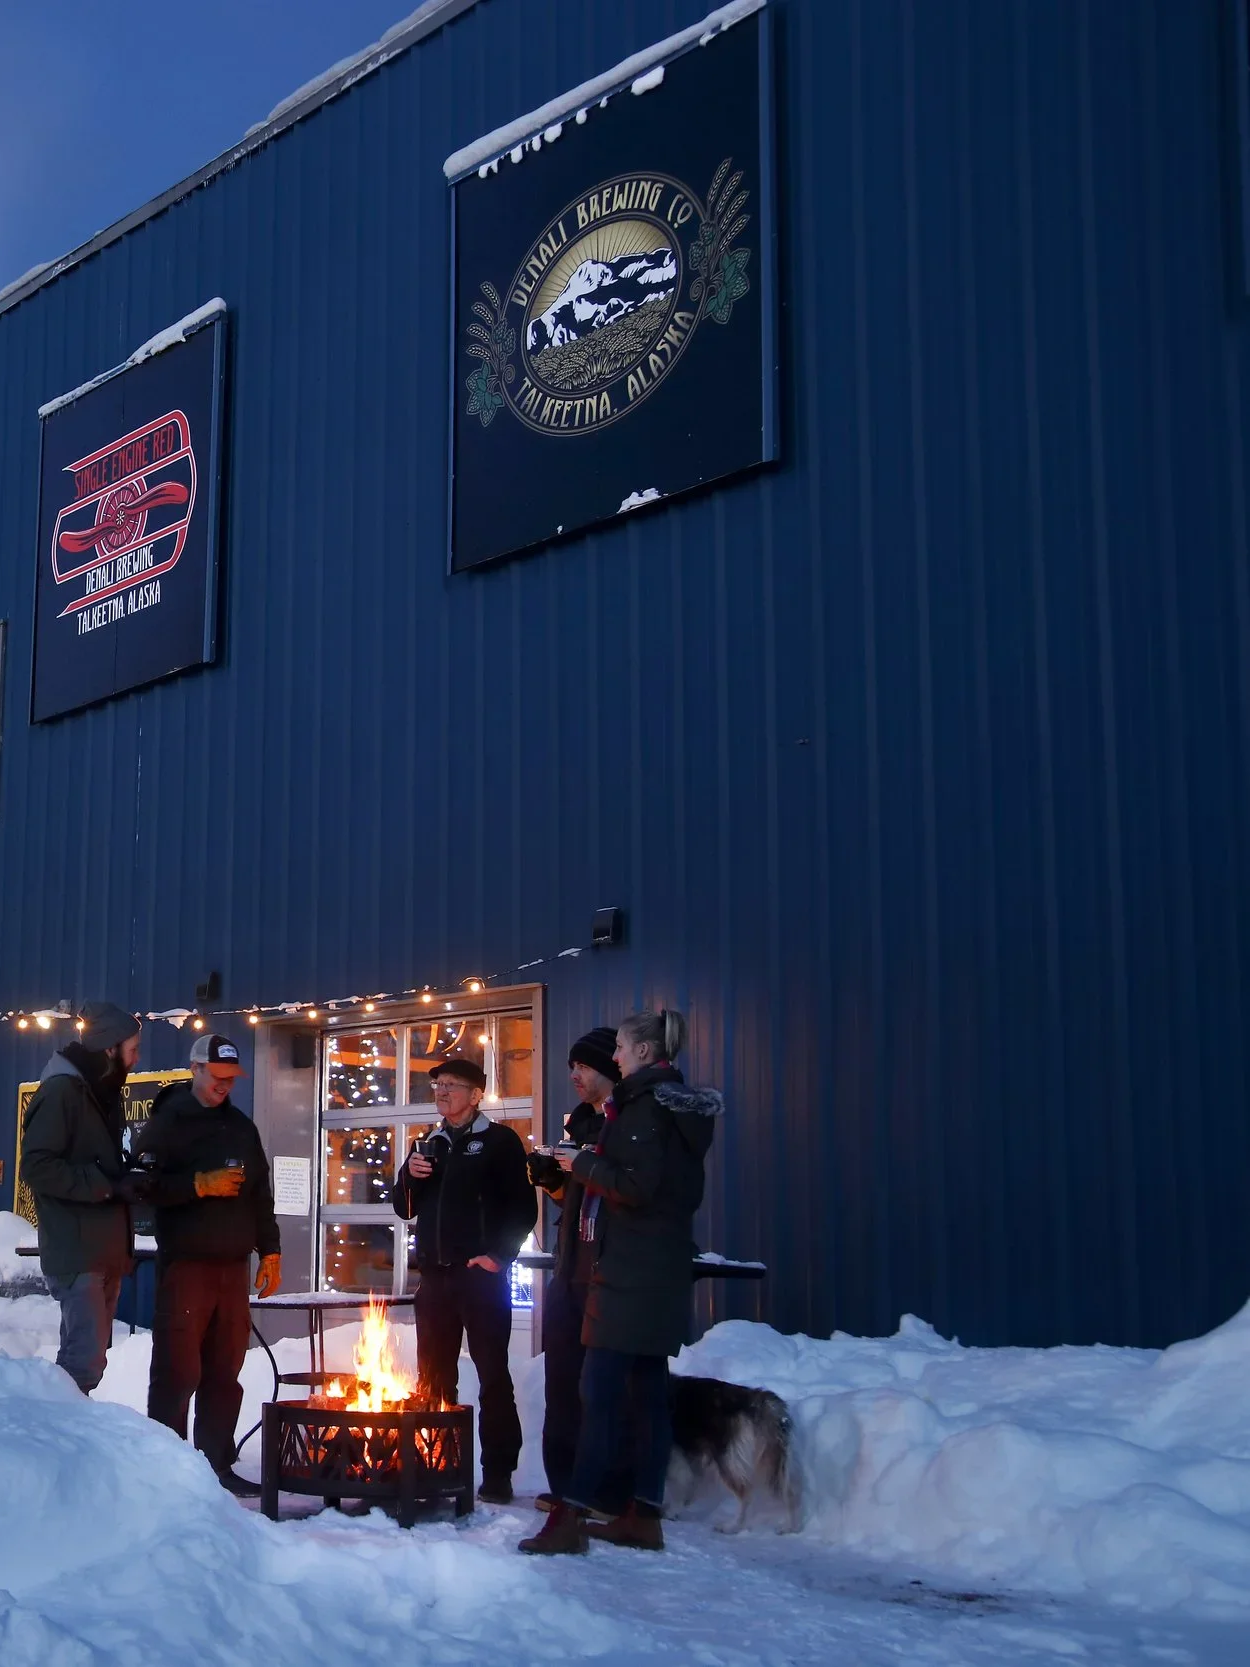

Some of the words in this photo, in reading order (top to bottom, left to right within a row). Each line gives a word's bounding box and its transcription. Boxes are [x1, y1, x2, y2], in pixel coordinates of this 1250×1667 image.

[511, 221, 568, 307] DENALI
[576, 181, 665, 230] BREWING
[514, 376, 619, 428] TALKEETNA,
[627, 310, 695, 401] ALASKA
[75, 457, 108, 499] SINGLE
[111, 436, 150, 481] ENGINE
[153, 425, 174, 461] RED
[85, 561, 115, 595] DENALI
[116, 543, 154, 582] BREWING
[77, 598, 126, 636] TALKEETNA,
[127, 579, 161, 614] ALASKA
